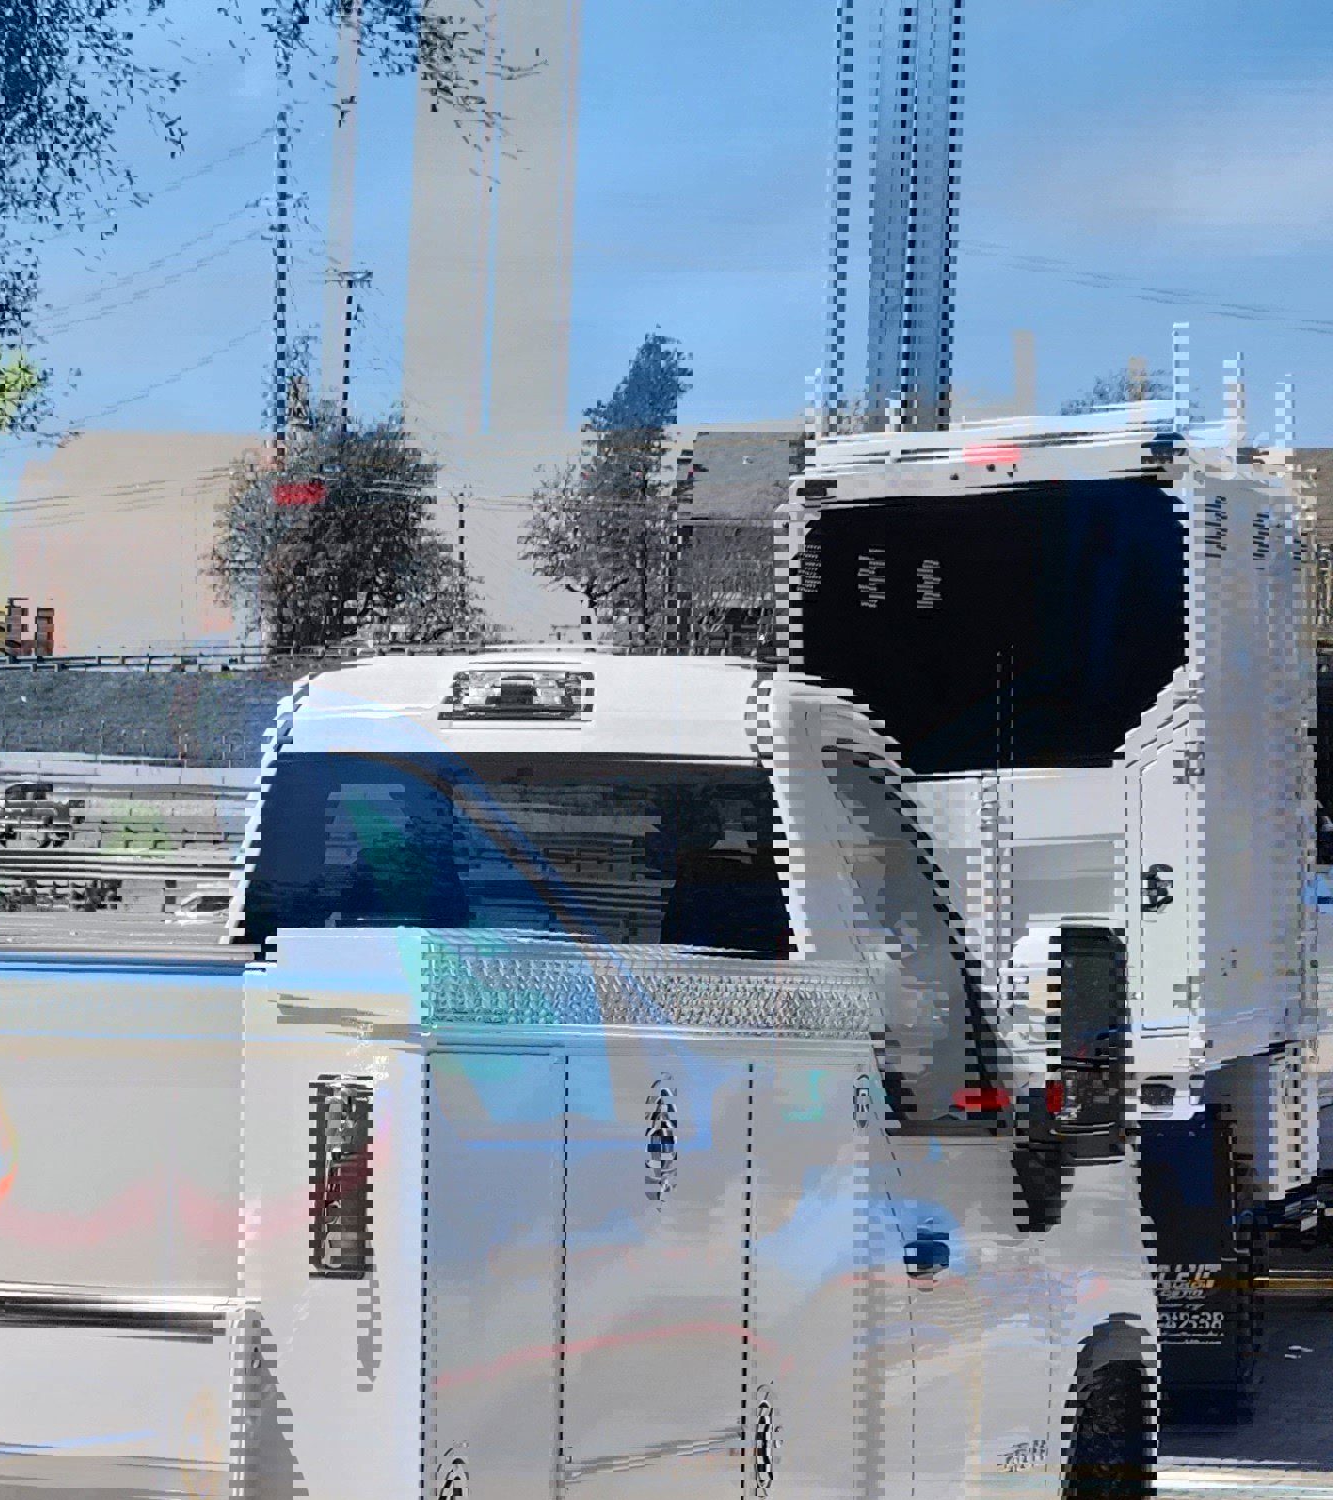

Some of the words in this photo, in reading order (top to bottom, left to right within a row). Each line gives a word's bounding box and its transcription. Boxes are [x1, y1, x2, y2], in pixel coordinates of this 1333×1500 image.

[378, 1096, 389, 1122] R
[669, 1447, 725, 1481] 2500
[728, 1443, 759, 1470] HD
